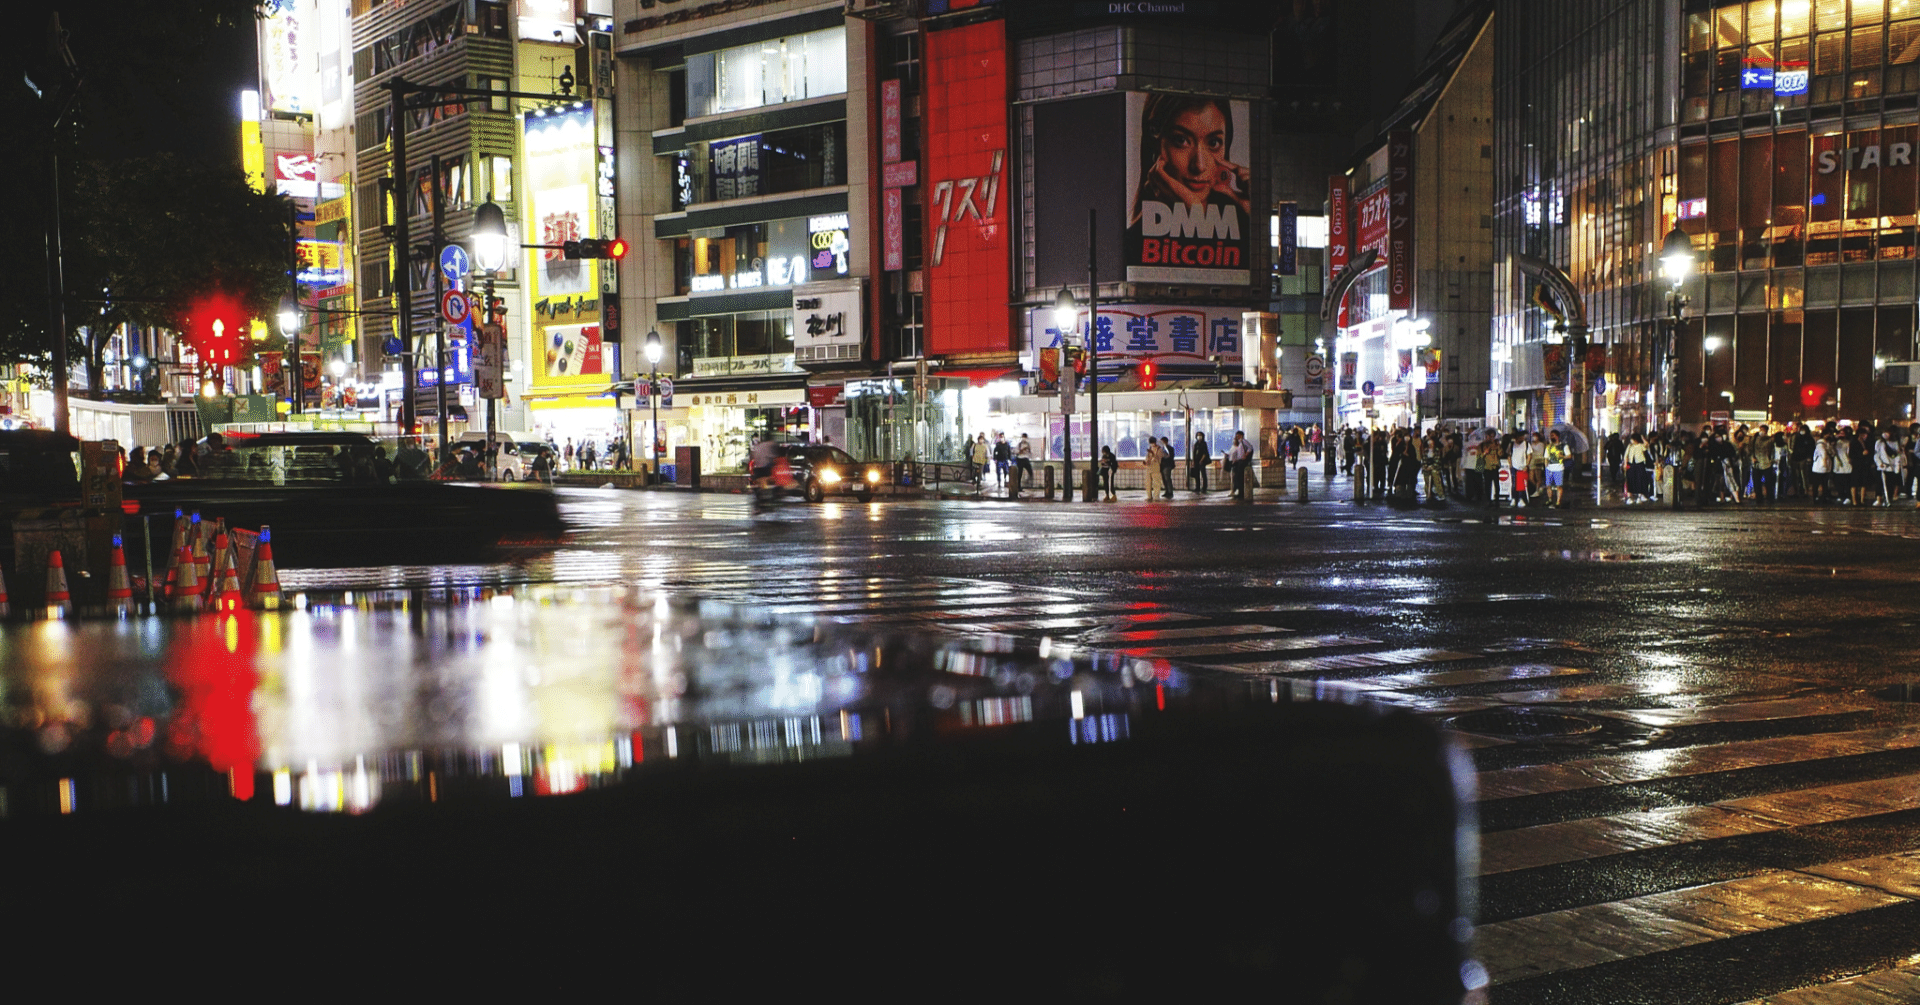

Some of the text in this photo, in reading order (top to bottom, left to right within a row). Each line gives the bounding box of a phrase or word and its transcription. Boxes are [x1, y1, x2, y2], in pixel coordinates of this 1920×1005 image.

[1108, 2, 1185, 14] DHC Channel
[1817, 142, 1911, 174] STAR
[1392, 143, 1408, 230] カラオケ
[931, 149, 1003, 267] クスリ
[1141, 200, 1241, 240] DMM
[1333, 188, 1343, 236] BIG ECHO
[1361, 192, 1390, 229] カラオケ
[1141, 239, 1241, 267] Bitcoin
[1393, 240, 1404, 294] BIG ECHO
